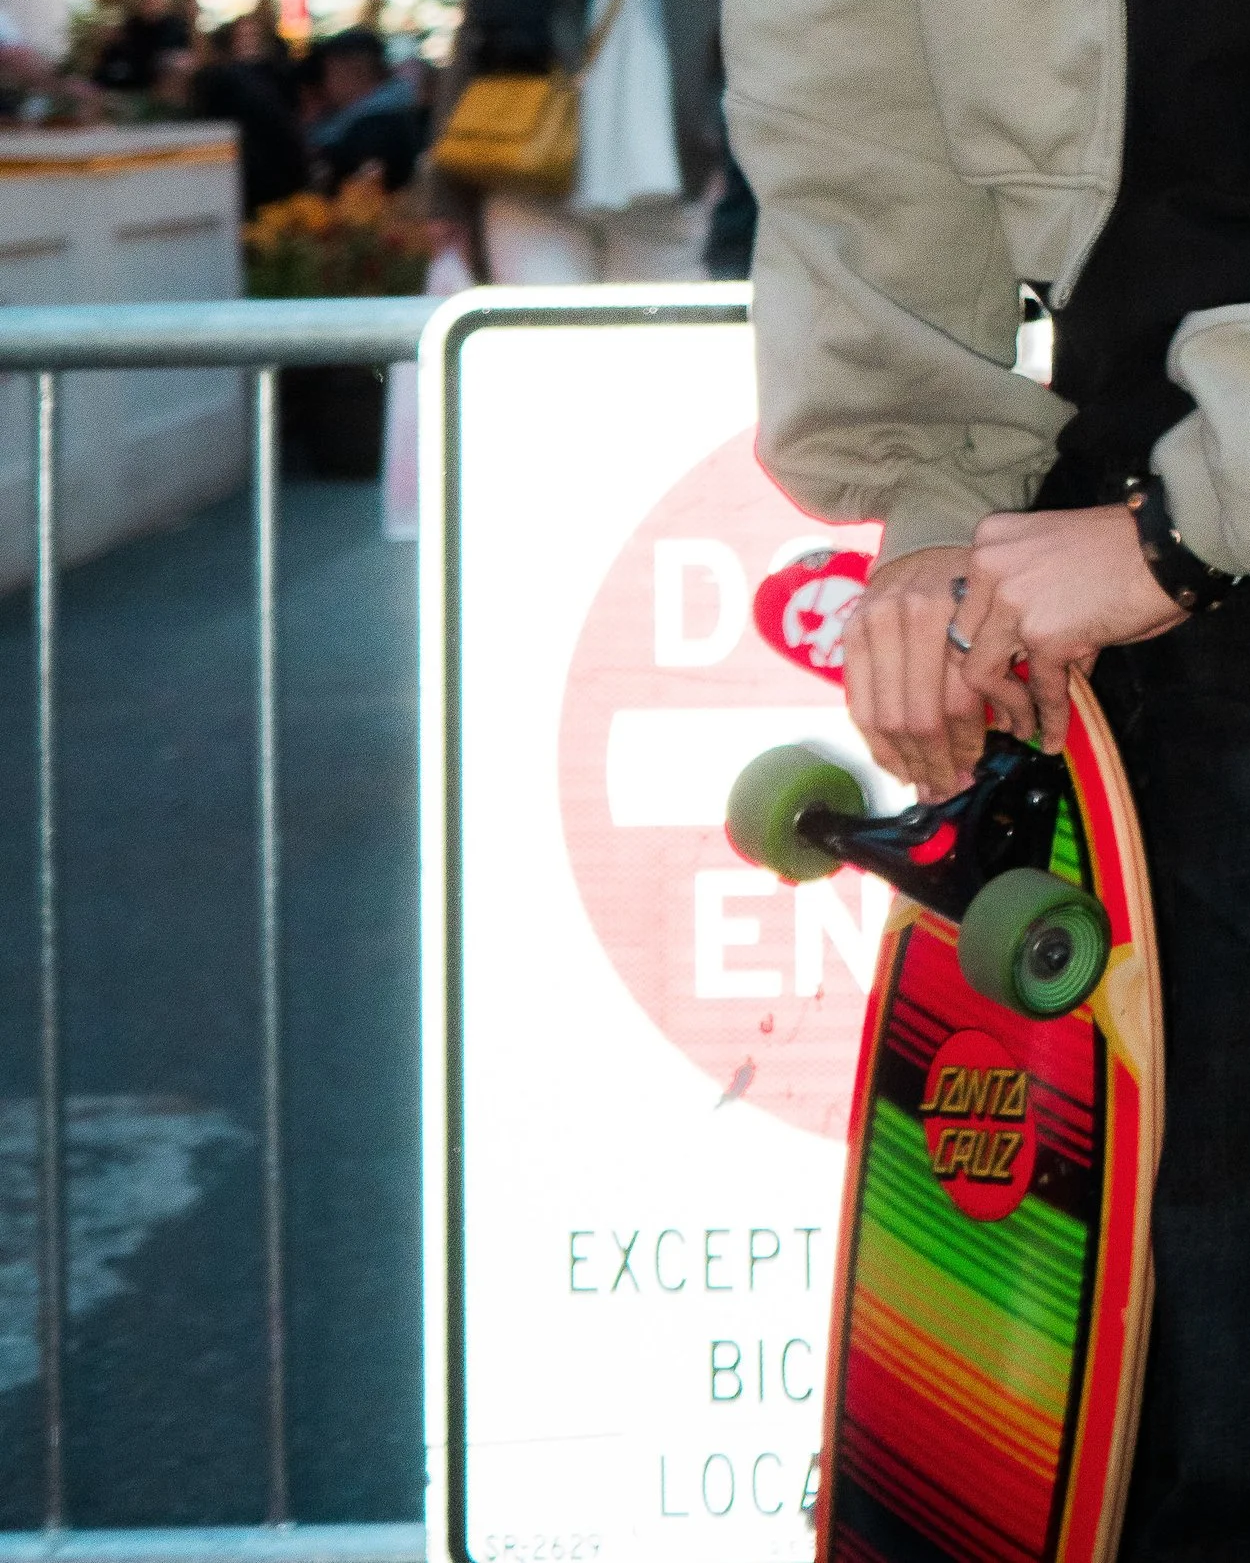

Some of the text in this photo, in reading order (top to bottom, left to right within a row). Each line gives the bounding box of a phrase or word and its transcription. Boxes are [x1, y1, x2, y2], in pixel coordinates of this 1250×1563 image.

[918, 1065, 1029, 1122] SANTA
[932, 1127, 1023, 1184] CRUZ
[569, 1228, 822, 1293] EXCEPT
[711, 1338, 813, 1403] BIC
